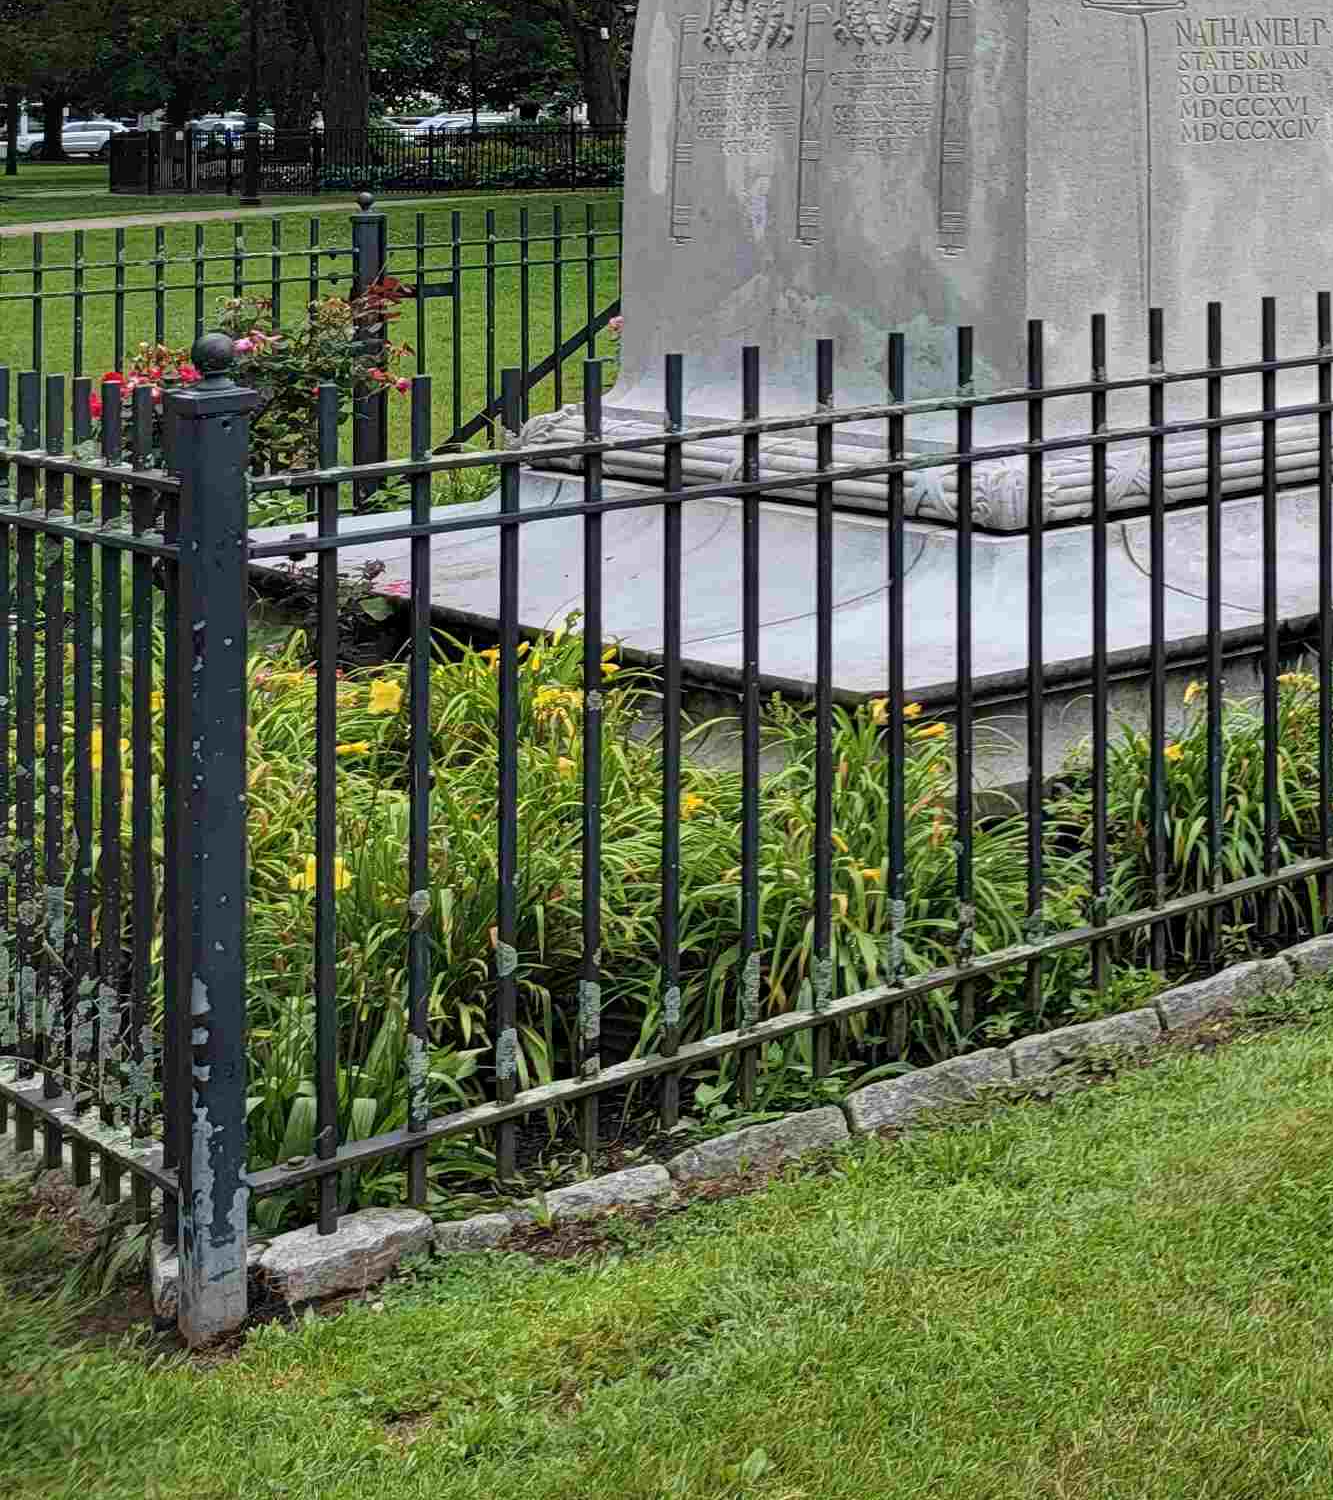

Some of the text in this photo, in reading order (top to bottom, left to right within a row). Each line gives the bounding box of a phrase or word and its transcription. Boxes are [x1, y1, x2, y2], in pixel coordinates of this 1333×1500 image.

[1177, 51, 1309, 71] STATESMAN
[1178, 74, 1285, 94] SOLDIER
[1180, 97, 1310, 118] MDCCCXVI
[1181, 119, 1321, 142] MDCCCXCIV
